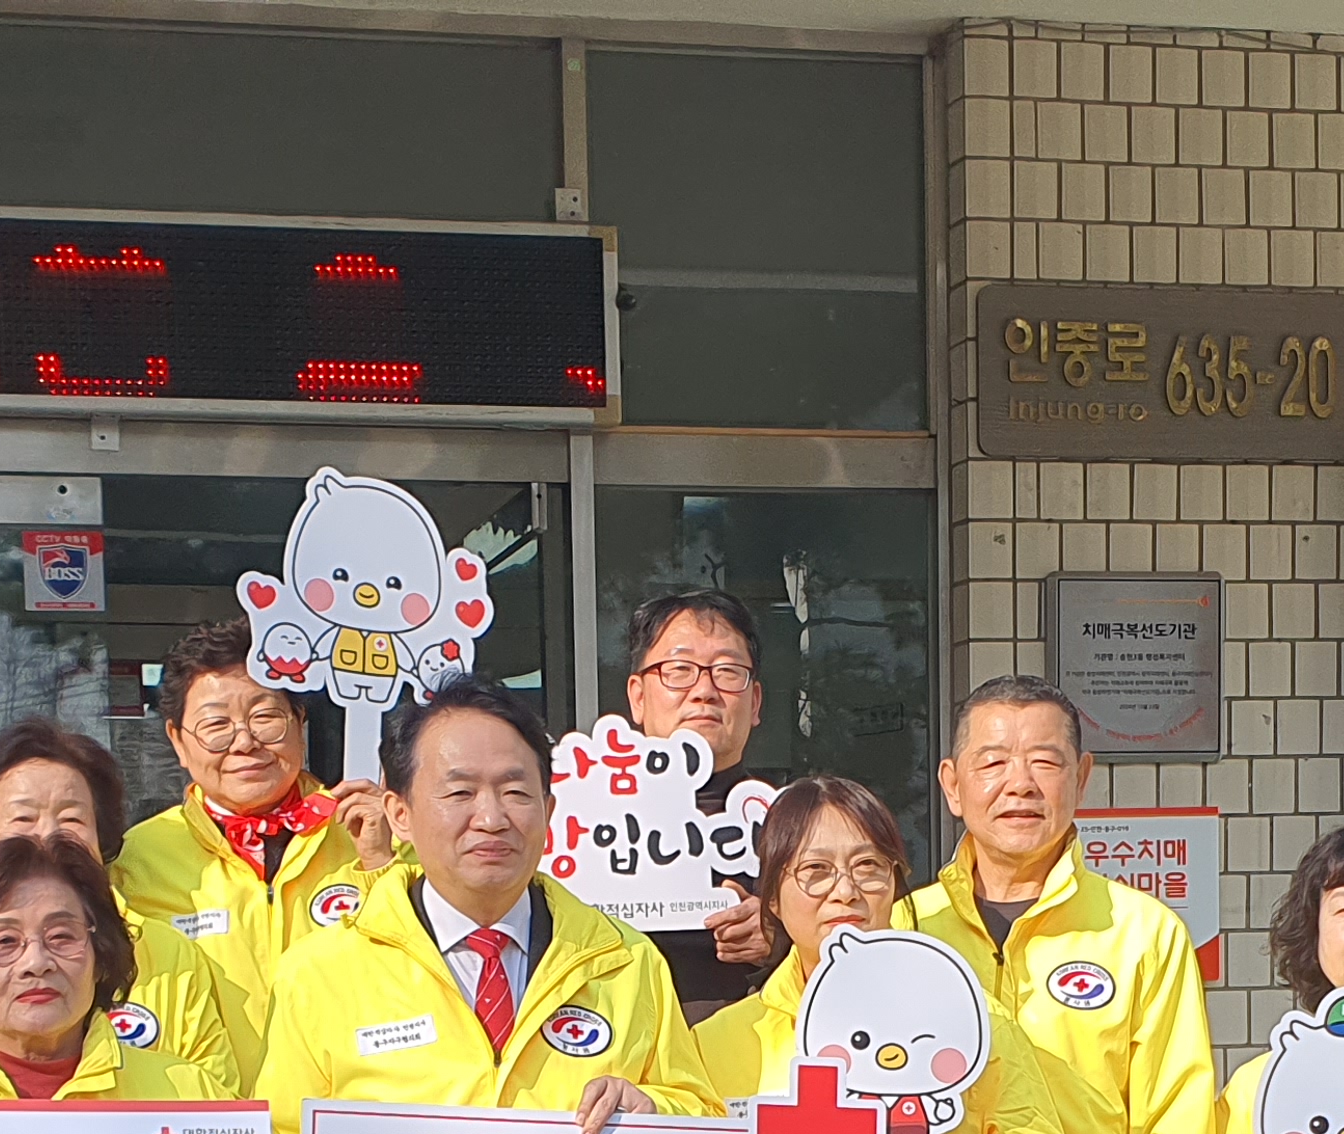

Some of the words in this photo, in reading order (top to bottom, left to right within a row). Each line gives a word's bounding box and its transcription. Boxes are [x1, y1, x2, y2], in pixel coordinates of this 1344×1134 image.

[1005, 318, 1150, 388] 인중로
[1166, 333, 1338, 419] 635-20
[1082, 622, 1197, 640] 치매극복선도기관
[551, 728, 700, 796] 나눔이
[543, 812, 761, 878] 망입니다
[1084, 838, 1187, 868] 우수치매
[1103, 872, 1188, 899] 마을
[594, 901, 665, 919] 적십자사
[669, 900, 728, 912] 인천광역시지사
